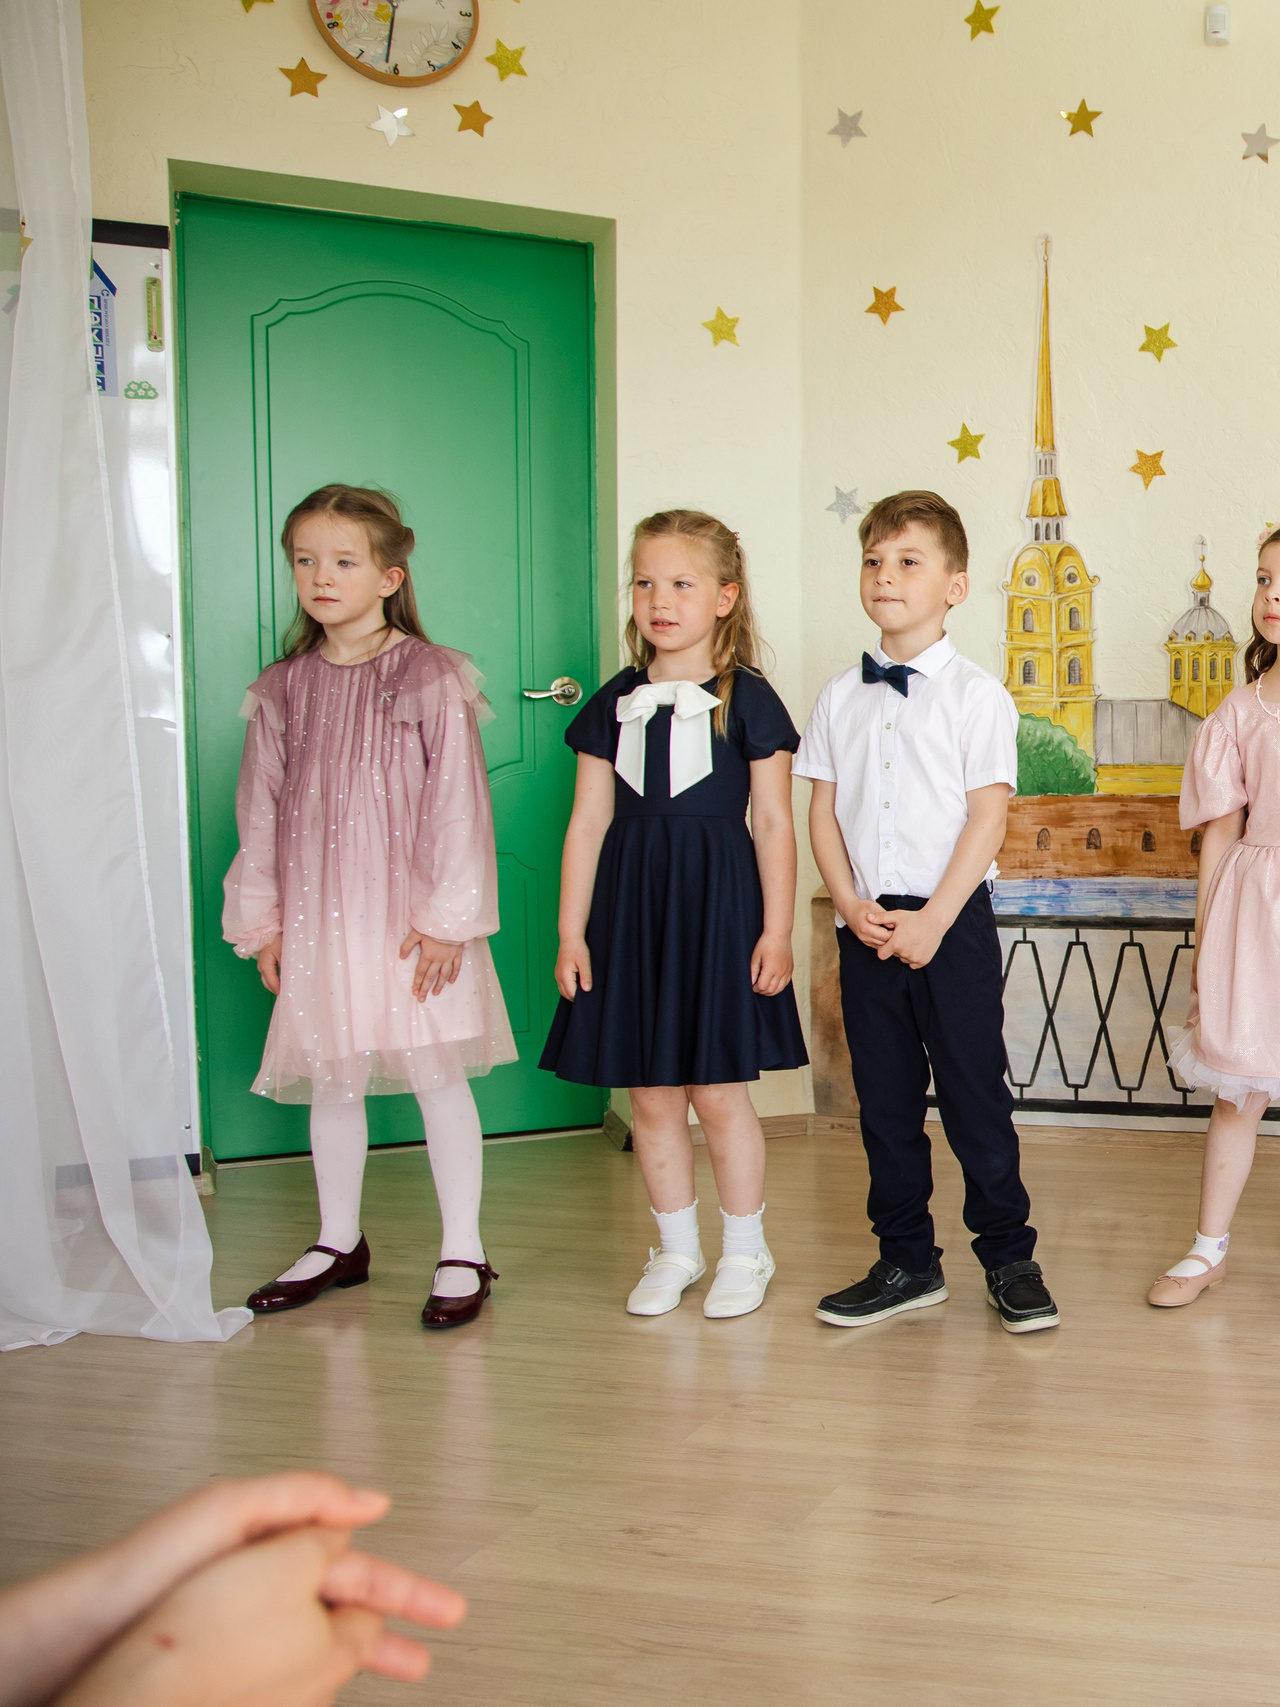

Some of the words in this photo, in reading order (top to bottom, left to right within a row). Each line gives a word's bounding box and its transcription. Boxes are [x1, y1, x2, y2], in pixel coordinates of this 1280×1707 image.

[459, 10, 472, 18] 3
[327, 21, 339, 29] 8
[451, 41, 462, 50] 4
[356, 49, 364, 59] 7
[393, 63, 399, 75] 6
[427, 60, 436, 71] 5
